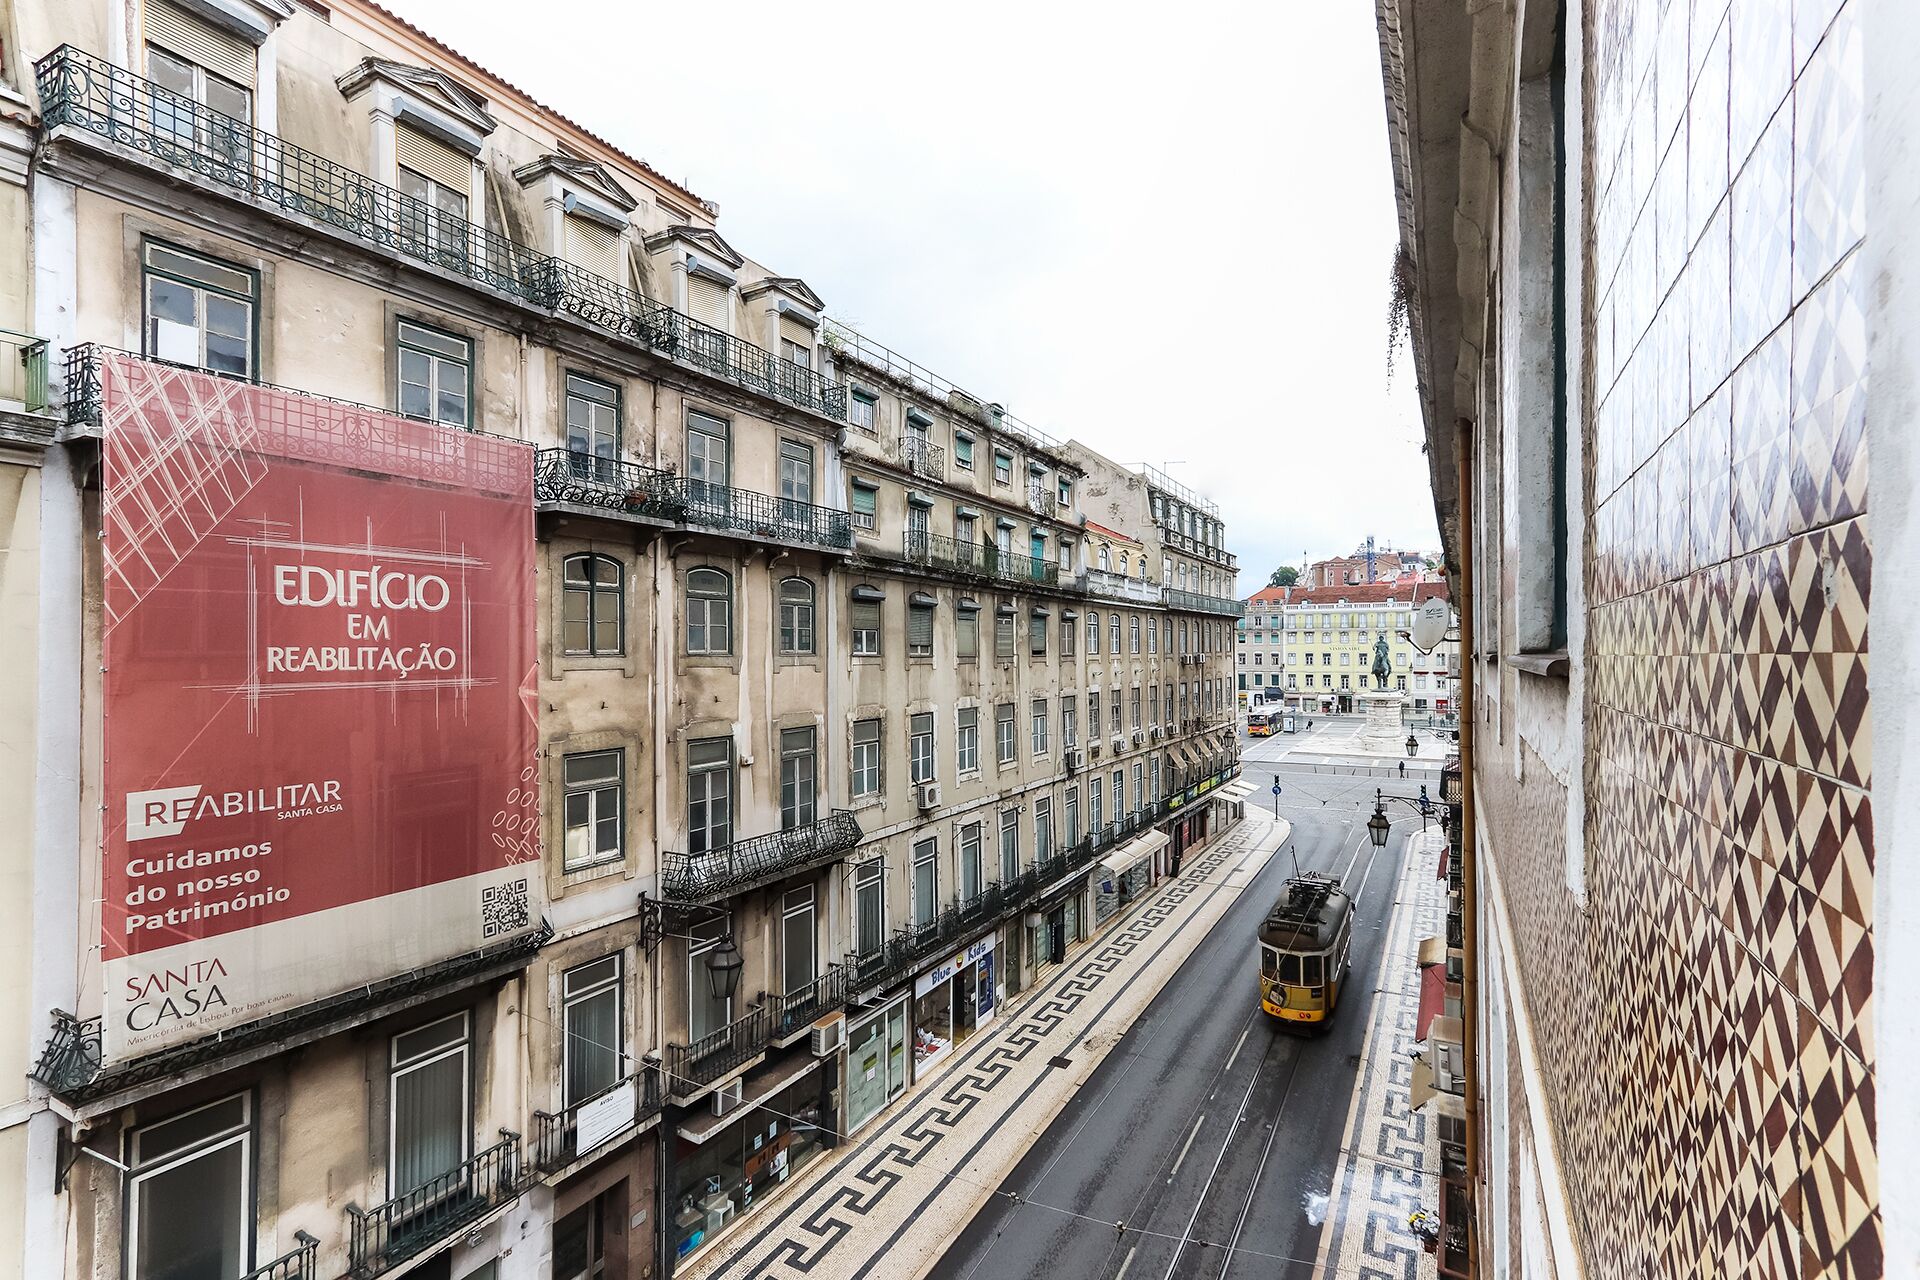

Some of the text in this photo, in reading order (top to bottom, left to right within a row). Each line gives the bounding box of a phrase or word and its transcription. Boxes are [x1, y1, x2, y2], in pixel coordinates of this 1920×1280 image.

[274, 565, 450, 612] EDIFÍCIO
[347, 613, 391, 642] EM
[267, 643, 456, 678] REABILITAÇÃO
[144, 780, 341, 827] REABILITAR
[277, 803, 343, 821] SANTA CASA
[125, 841, 273, 878] Cuidamos
[125, 869, 261, 906] do nosso
[125, 887, 291, 935] Património
[126, 957, 228, 1002] SANTA
[931, 941, 987, 986] Blue Kids
[126, 984, 228, 1032] CASA
[186, 1019, 198, 1029] de
[231, 1006, 244, 1014] Por
[246, 1001, 266, 1011] boas
